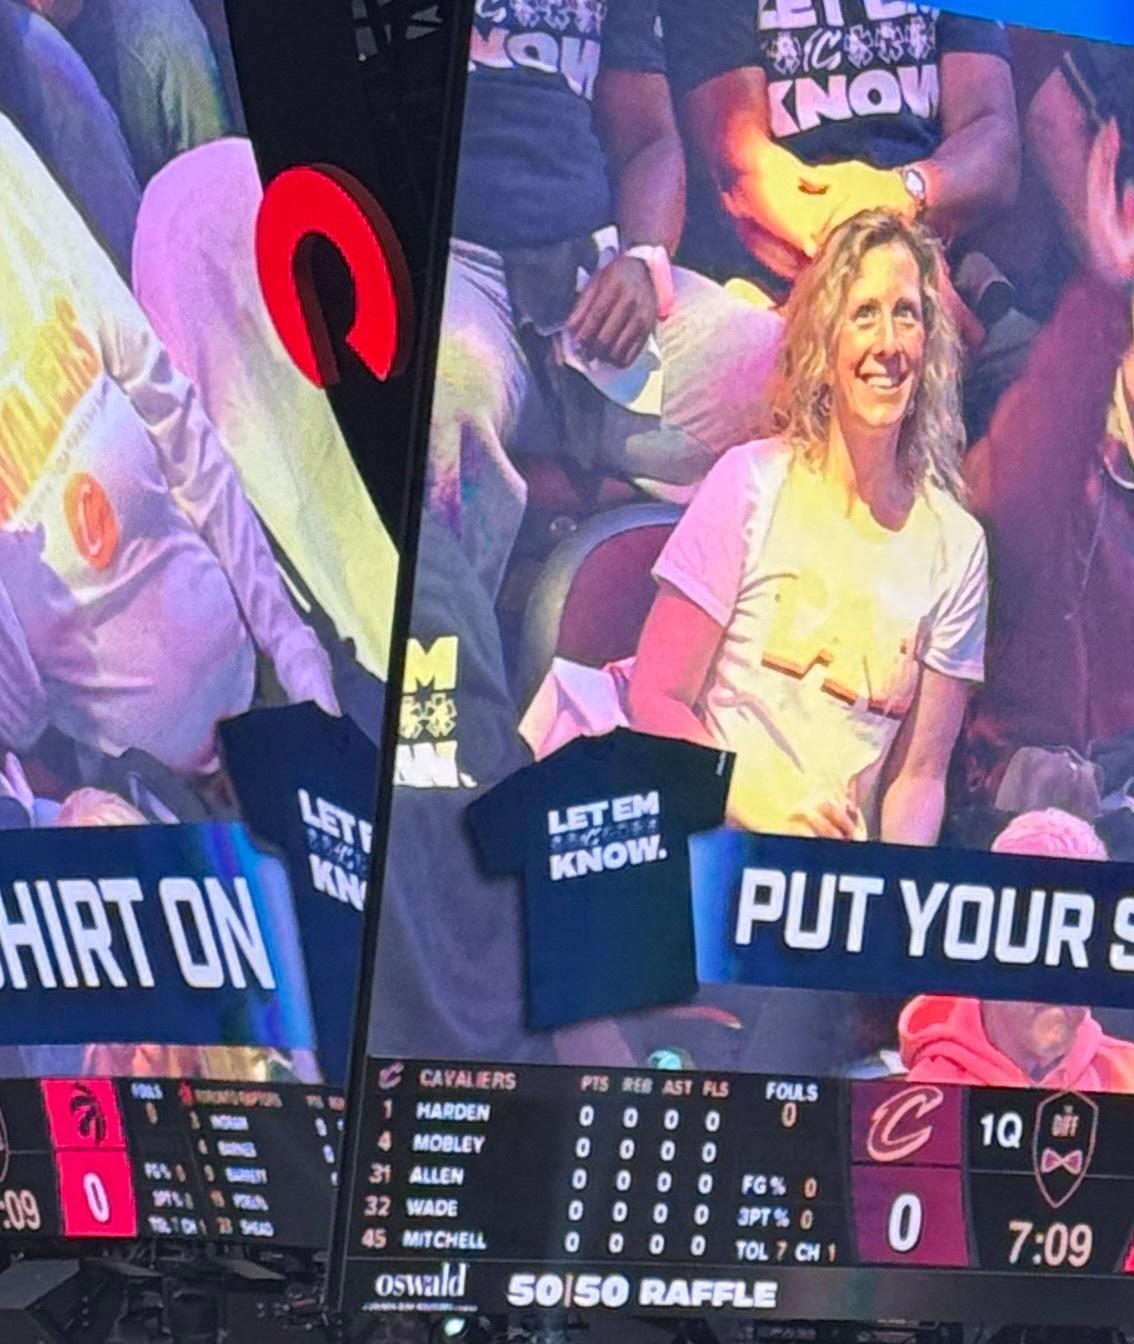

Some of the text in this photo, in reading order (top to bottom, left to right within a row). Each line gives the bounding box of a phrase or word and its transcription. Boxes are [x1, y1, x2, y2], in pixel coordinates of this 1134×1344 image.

[548, 790, 661, 836] LET EM
[549, 834, 669, 882] KNOW.
[734, 867, 884, 953] PUT
[899, 878, 1097, 969] YOUR
[157, 876, 278, 991] ON
[582, 1076, 608, 1091] PTS
[663, 1080, 692, 1094] AST
[704, 1081, 728, 1097] FLS
[767, 1082, 817, 1104] FOULS
[384, 1100, 719, 1131] 1 HARDEN 0 0 0 0
[783, 1103, 796, 1126] 0
[379, 1132, 716, 1162] 4 MOBLEY 0 0 0 0
[370, 1164, 712, 1193] 31 ALLEN 0 0 0 0
[743, 1175, 816, 1197] FG % 0
[83, 1172, 111, 1224] 0
[365, 1196, 709, 1224] 32 WADE 0 0 0 0
[738, 1208, 812, 1229] 3PT % 0
[887, 1194, 922, 1252] 0
[362, 1229, 486, 1249] 45 MITCHELL
[737, 1241, 835, 1261] TOL 7 CH 1
[1007, 1221, 1094, 1267] 7:09
[375, 1262, 468, 1298] oswald
[639, 1279, 778, 1308] RAFFLE
